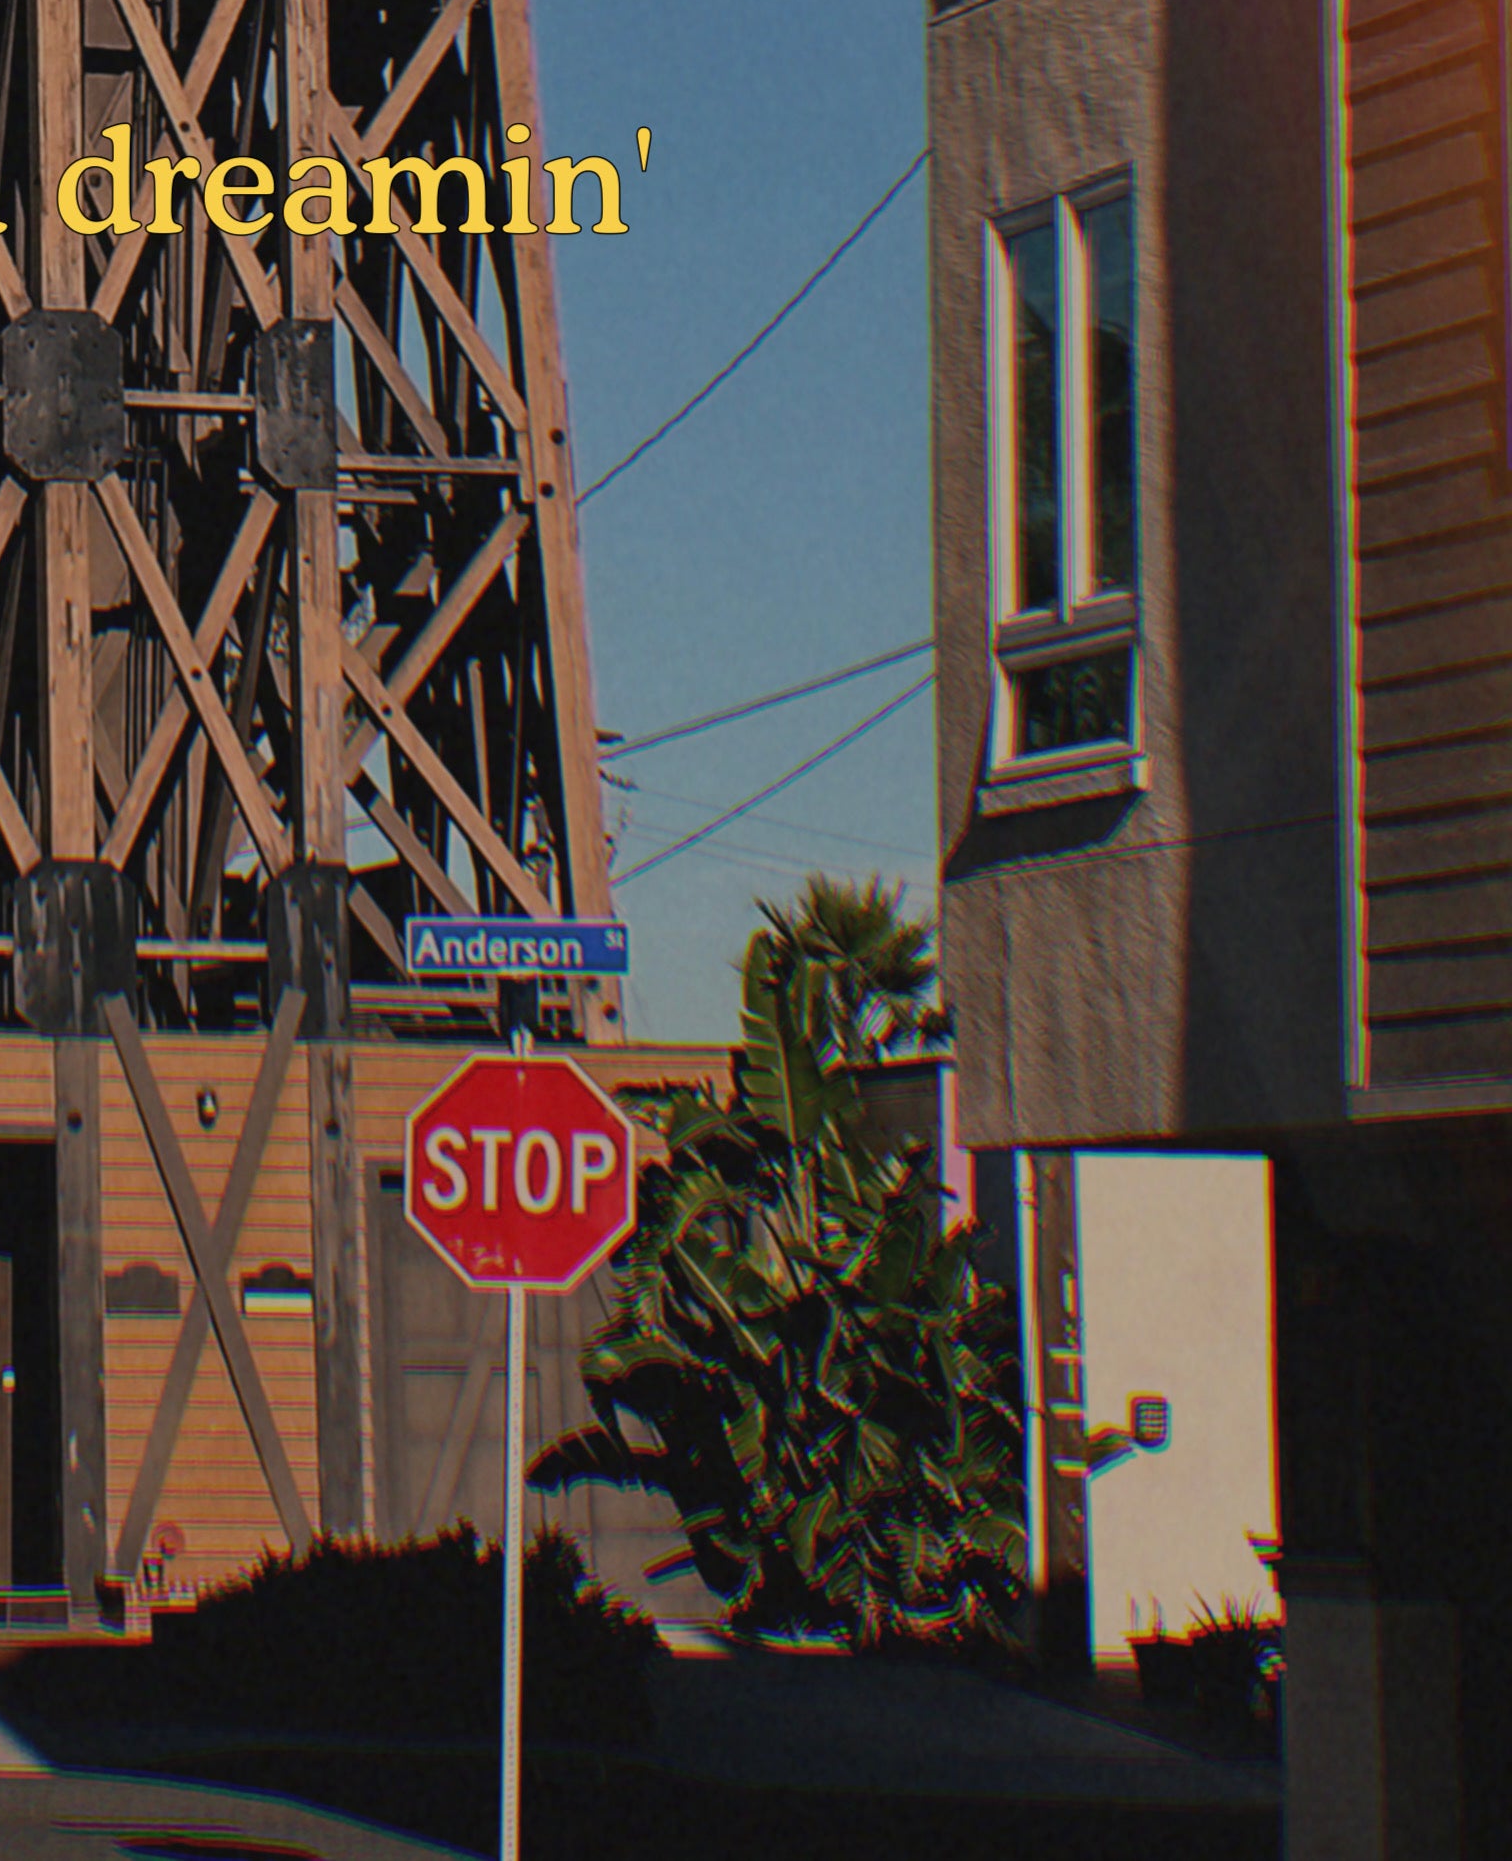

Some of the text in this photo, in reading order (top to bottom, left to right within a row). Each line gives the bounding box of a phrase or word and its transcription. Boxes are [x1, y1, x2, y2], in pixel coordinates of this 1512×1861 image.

[413, 927, 625, 967] Anderson St
[422, 1127, 617, 1214] STOP
